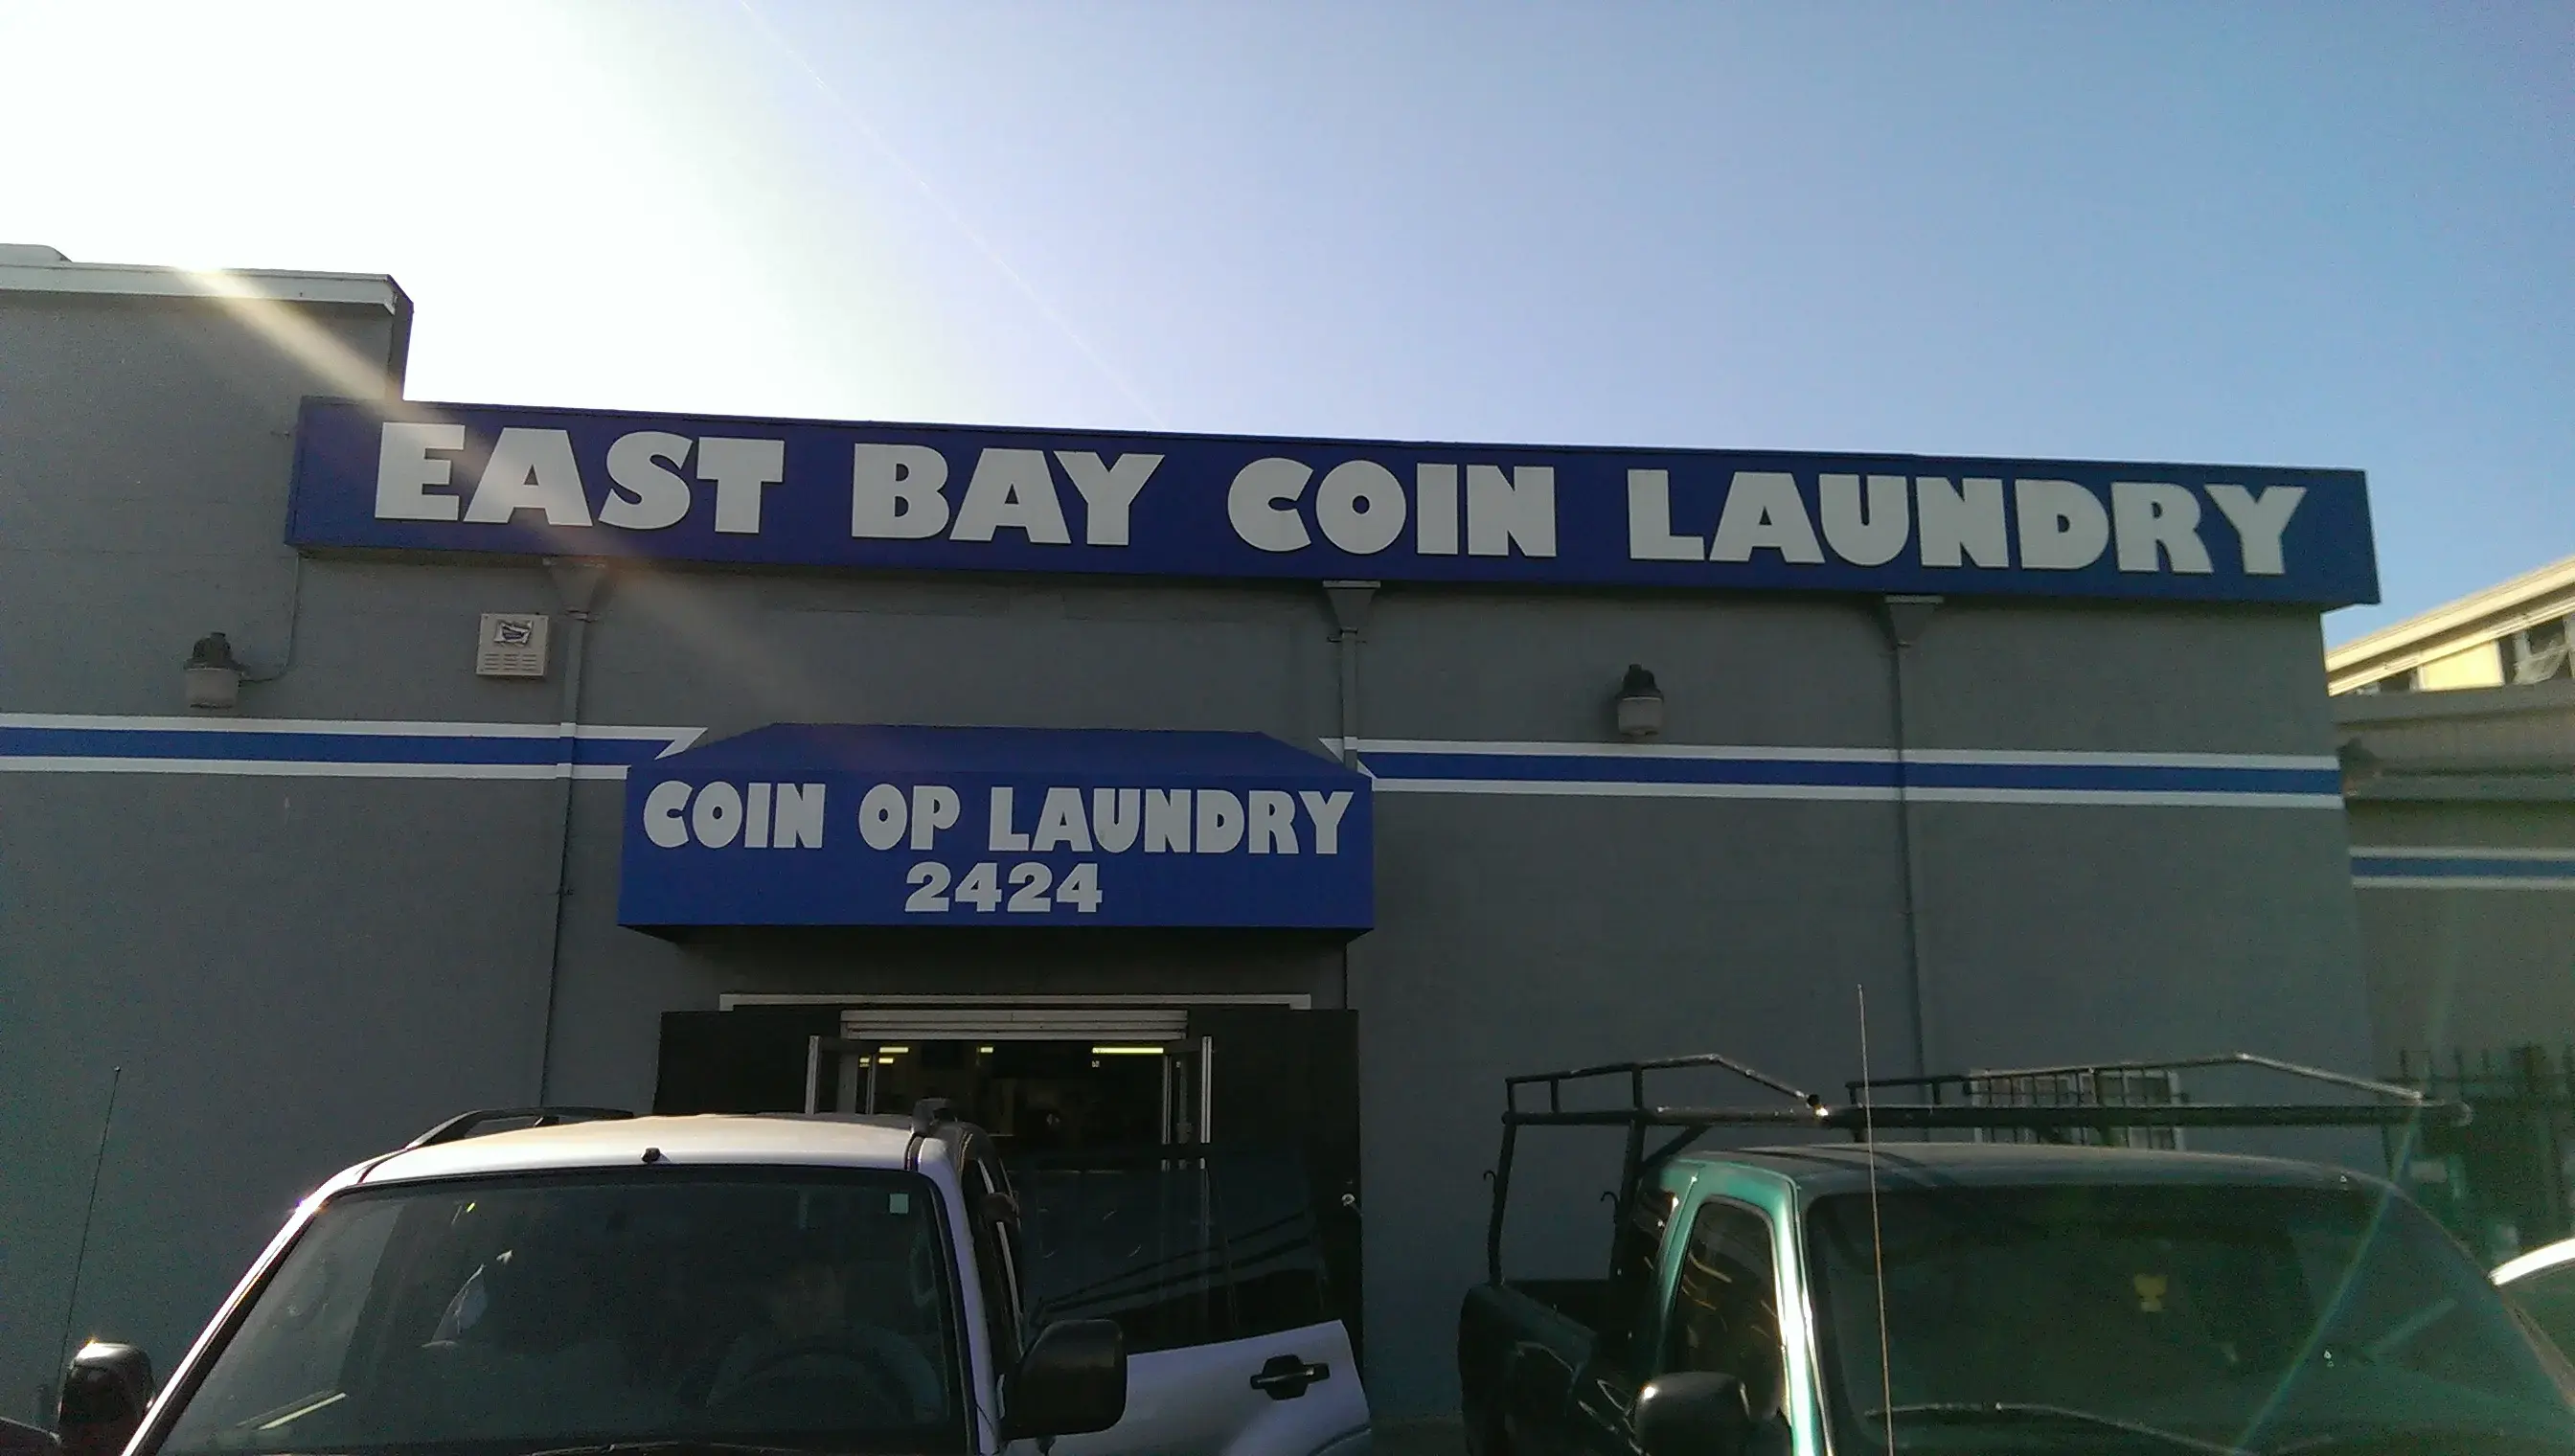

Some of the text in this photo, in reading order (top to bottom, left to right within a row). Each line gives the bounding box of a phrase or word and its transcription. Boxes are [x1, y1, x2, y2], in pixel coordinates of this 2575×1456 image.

[375, 422, 2309, 575] EAST BAY COIN LAUNDRY
[643, 780, 1354, 854] COIN OP LAUNDRY
[904, 861, 1103, 913] 2424
